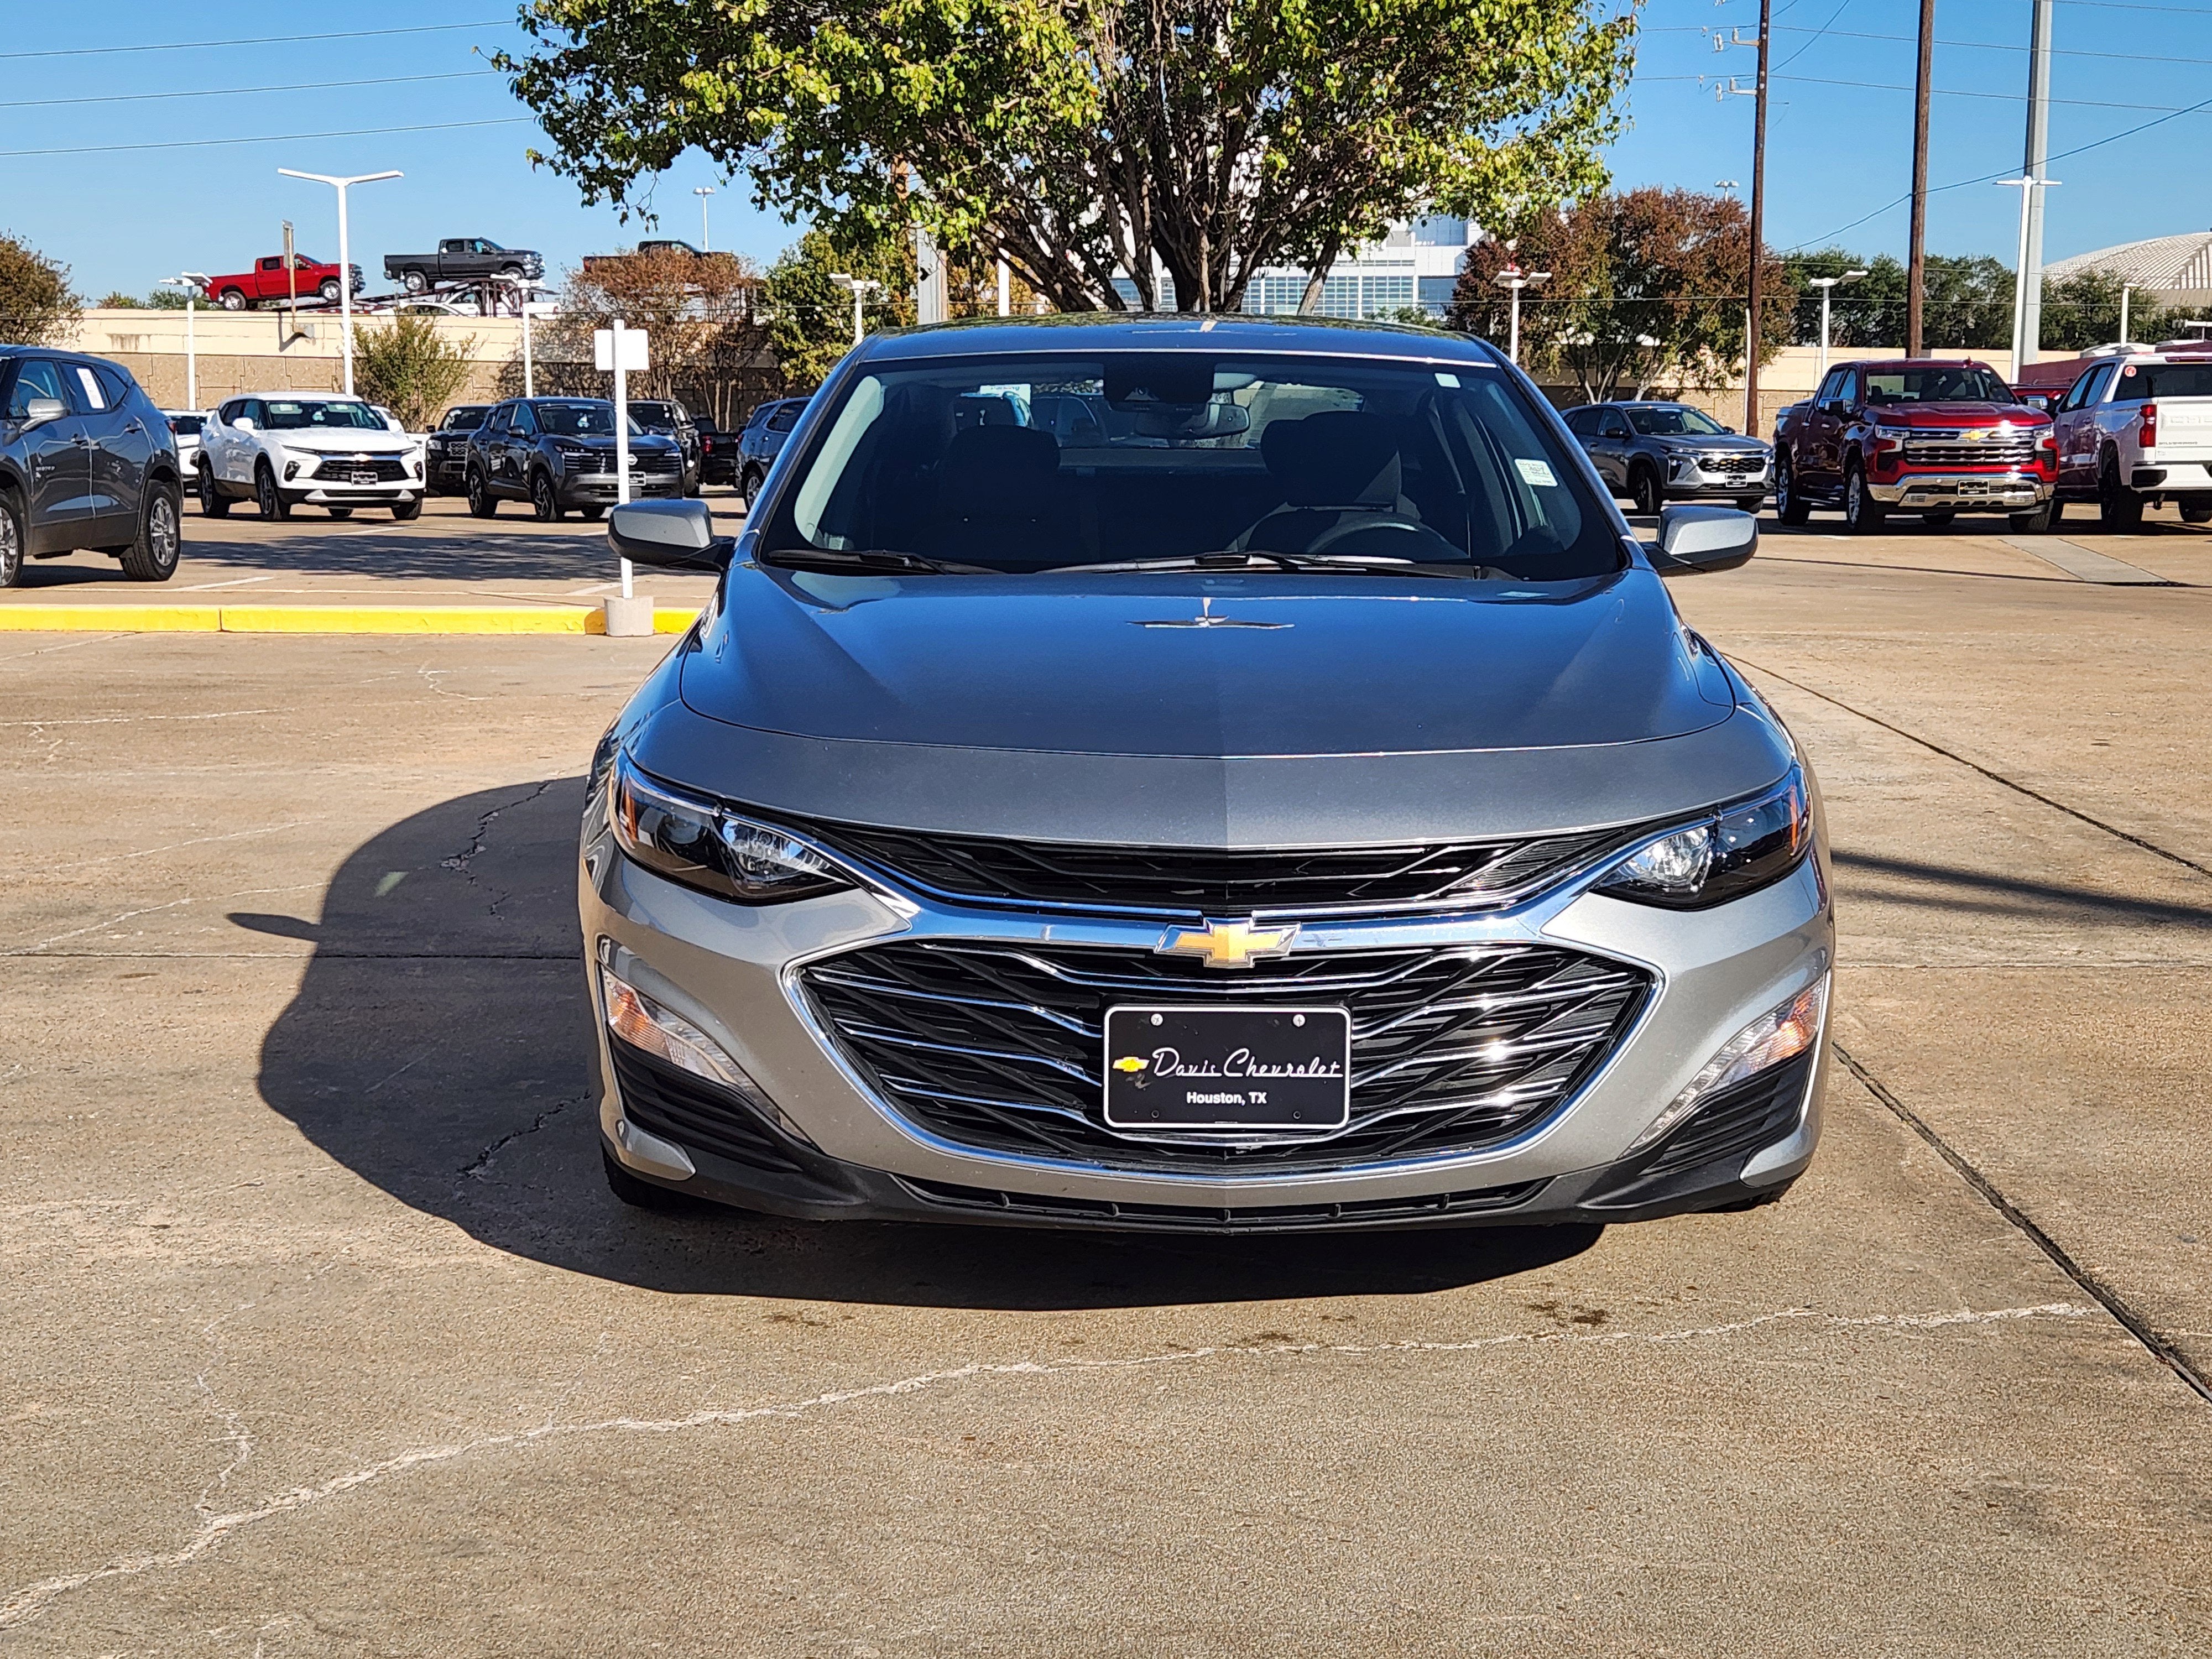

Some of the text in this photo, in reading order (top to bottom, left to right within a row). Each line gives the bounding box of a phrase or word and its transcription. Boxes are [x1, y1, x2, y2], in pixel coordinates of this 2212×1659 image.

[1151, 1047, 1344, 1078] Davis Chevrolet
[1186, 1091, 1267, 1107] Houston, TX
